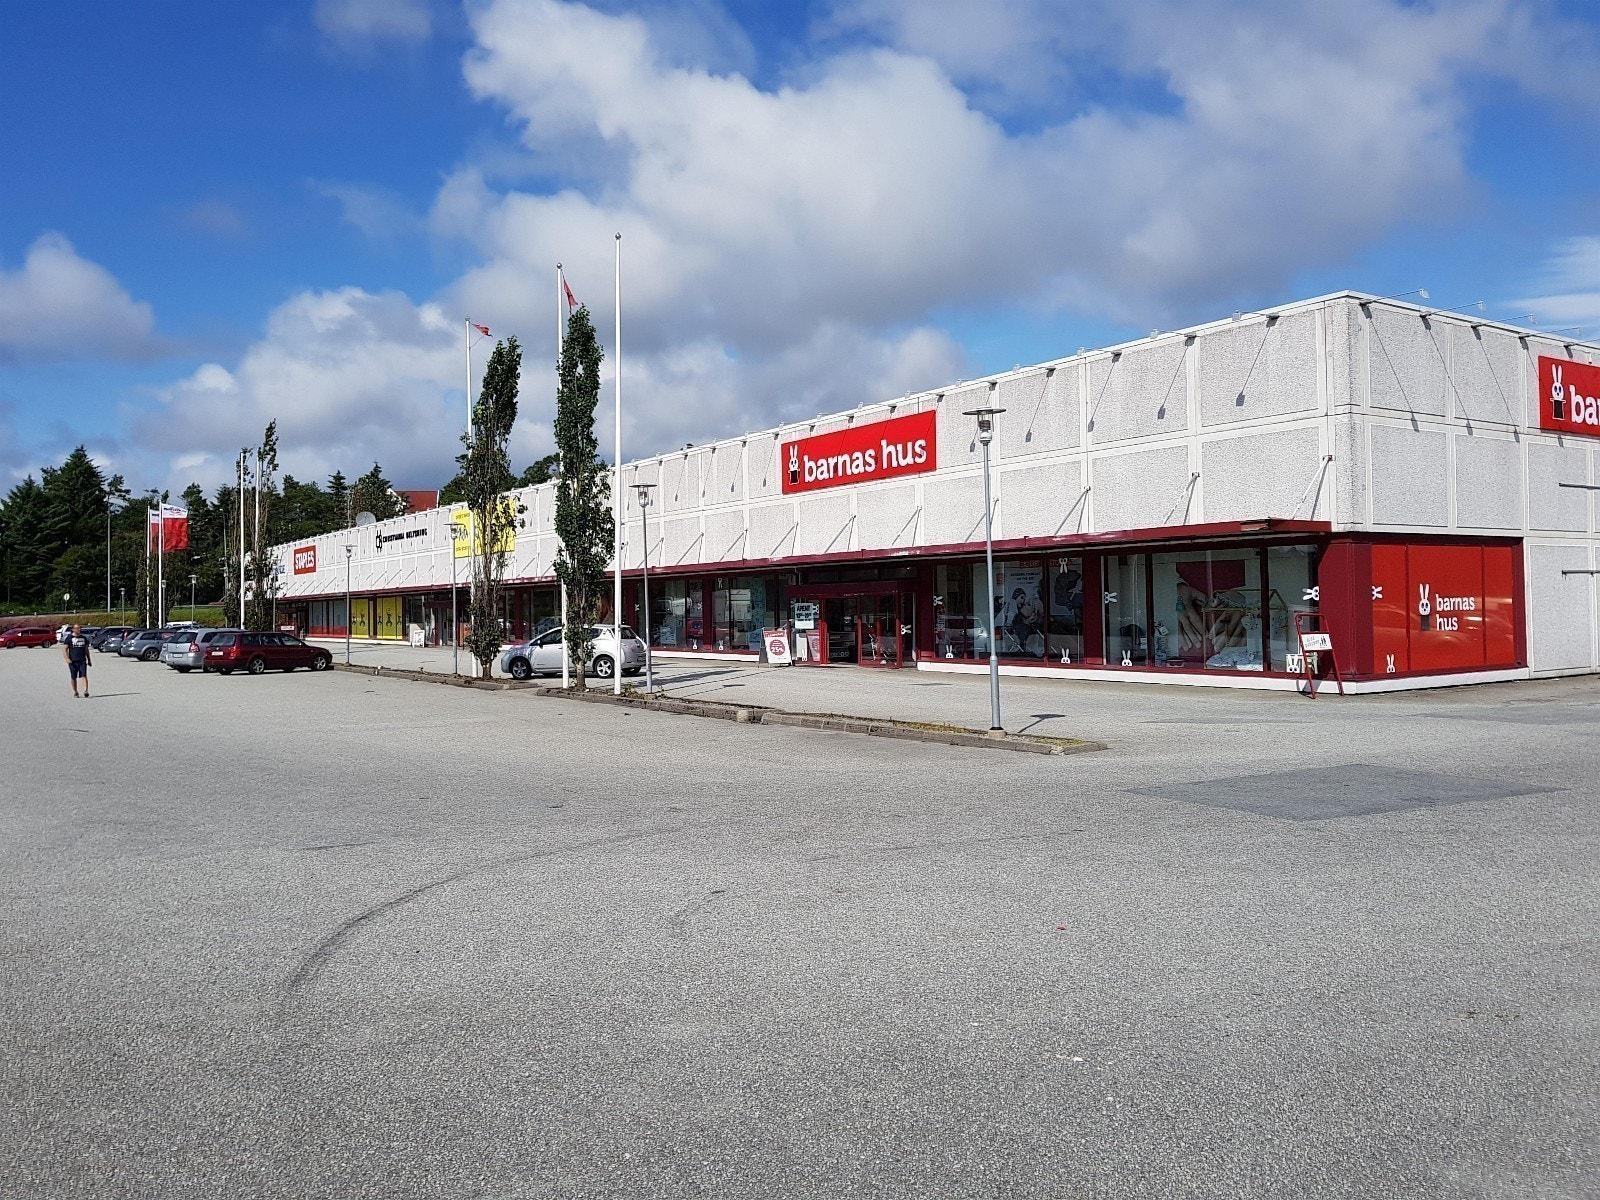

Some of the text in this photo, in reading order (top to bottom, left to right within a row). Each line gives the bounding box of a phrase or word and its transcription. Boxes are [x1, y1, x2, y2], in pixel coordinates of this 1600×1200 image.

[803, 439, 927, 483] barnas hus
[295, 550, 315, 569] STAPLES
[1435, 593, 1475, 611] barnas
[1435, 613, 1458, 631] hus
